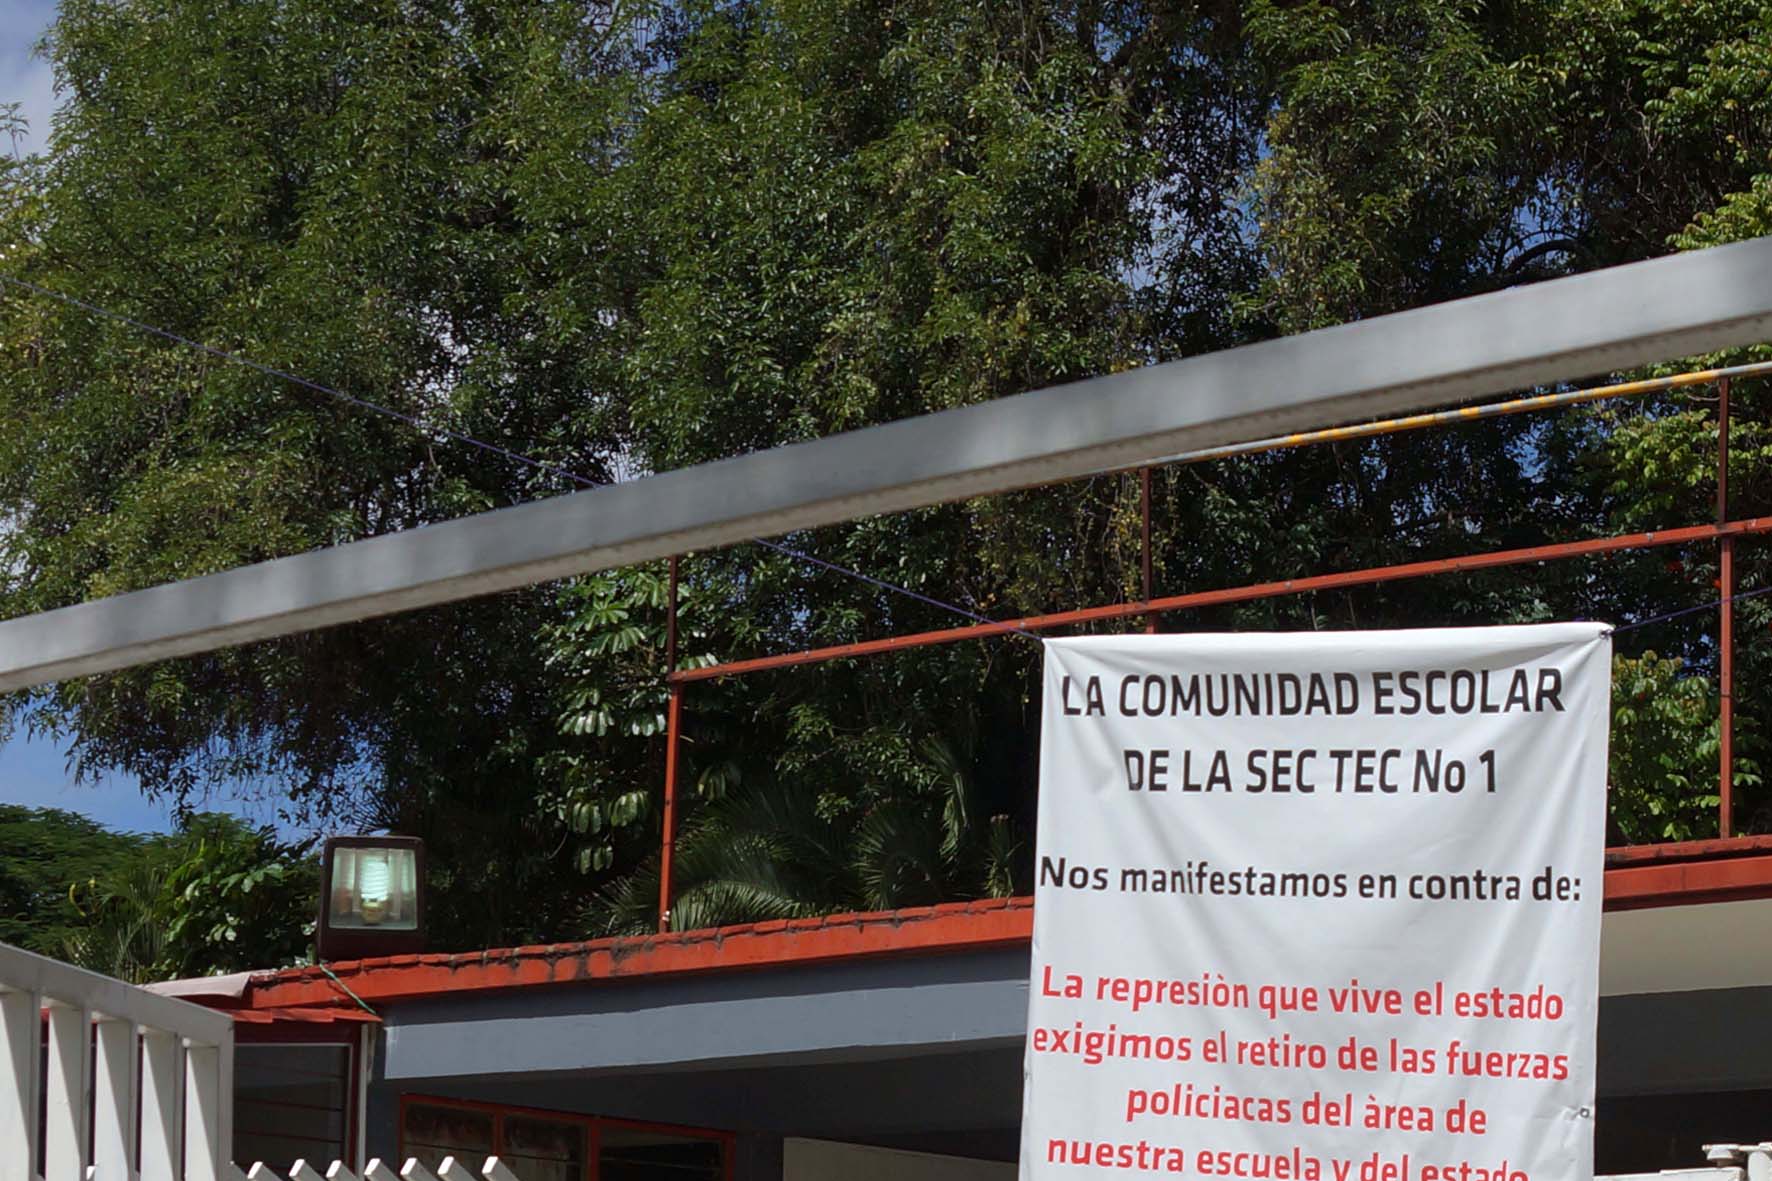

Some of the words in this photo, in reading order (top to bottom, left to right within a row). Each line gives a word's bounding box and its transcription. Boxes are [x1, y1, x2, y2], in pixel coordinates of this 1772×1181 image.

[1062, 675, 1106, 717] LA
[1119, 672, 1359, 717] COMUNIDAD
[1371, 668, 1565, 715] ESCOLAR
[1123, 749, 1170, 792] DE
[1182, 750, 1232, 793] LA
[1245, 749, 1317, 793] SEC
[1329, 749, 1401, 794] TEC
[1413, 749, 1466, 794] No
[1479, 749, 1496, 793] 1
[1040, 856, 1108, 891] Nos
[1120, 861, 1347, 898] manifestamos
[1358, 874, 1397, 899] en
[1409, 869, 1521, 901] contra
[1532, 865, 1581, 901] de:
[1041, 964, 1084, 1000] La
[1258, 984, 1320, 1021] que
[1327, 979, 1403, 1016] vive
[1412, 981, 1444, 1017] el
[1453, 984, 1564, 1021] estado
[1032, 1020, 1193, 1066] exigimos
[1201, 1031, 1228, 1064] el
[1236, 1033, 1328, 1070] retiro
[1336, 1036, 1379, 1073] de
[1389, 1038, 1437, 1075] las
[1445, 1039, 1569, 1082] fuerzas
[1125, 1082, 1293, 1125] policiacas
[1301, 1091, 1353, 1128] del
[1444, 1098, 1488, 1136] de
[1047, 1138, 1185, 1173] nuestra
